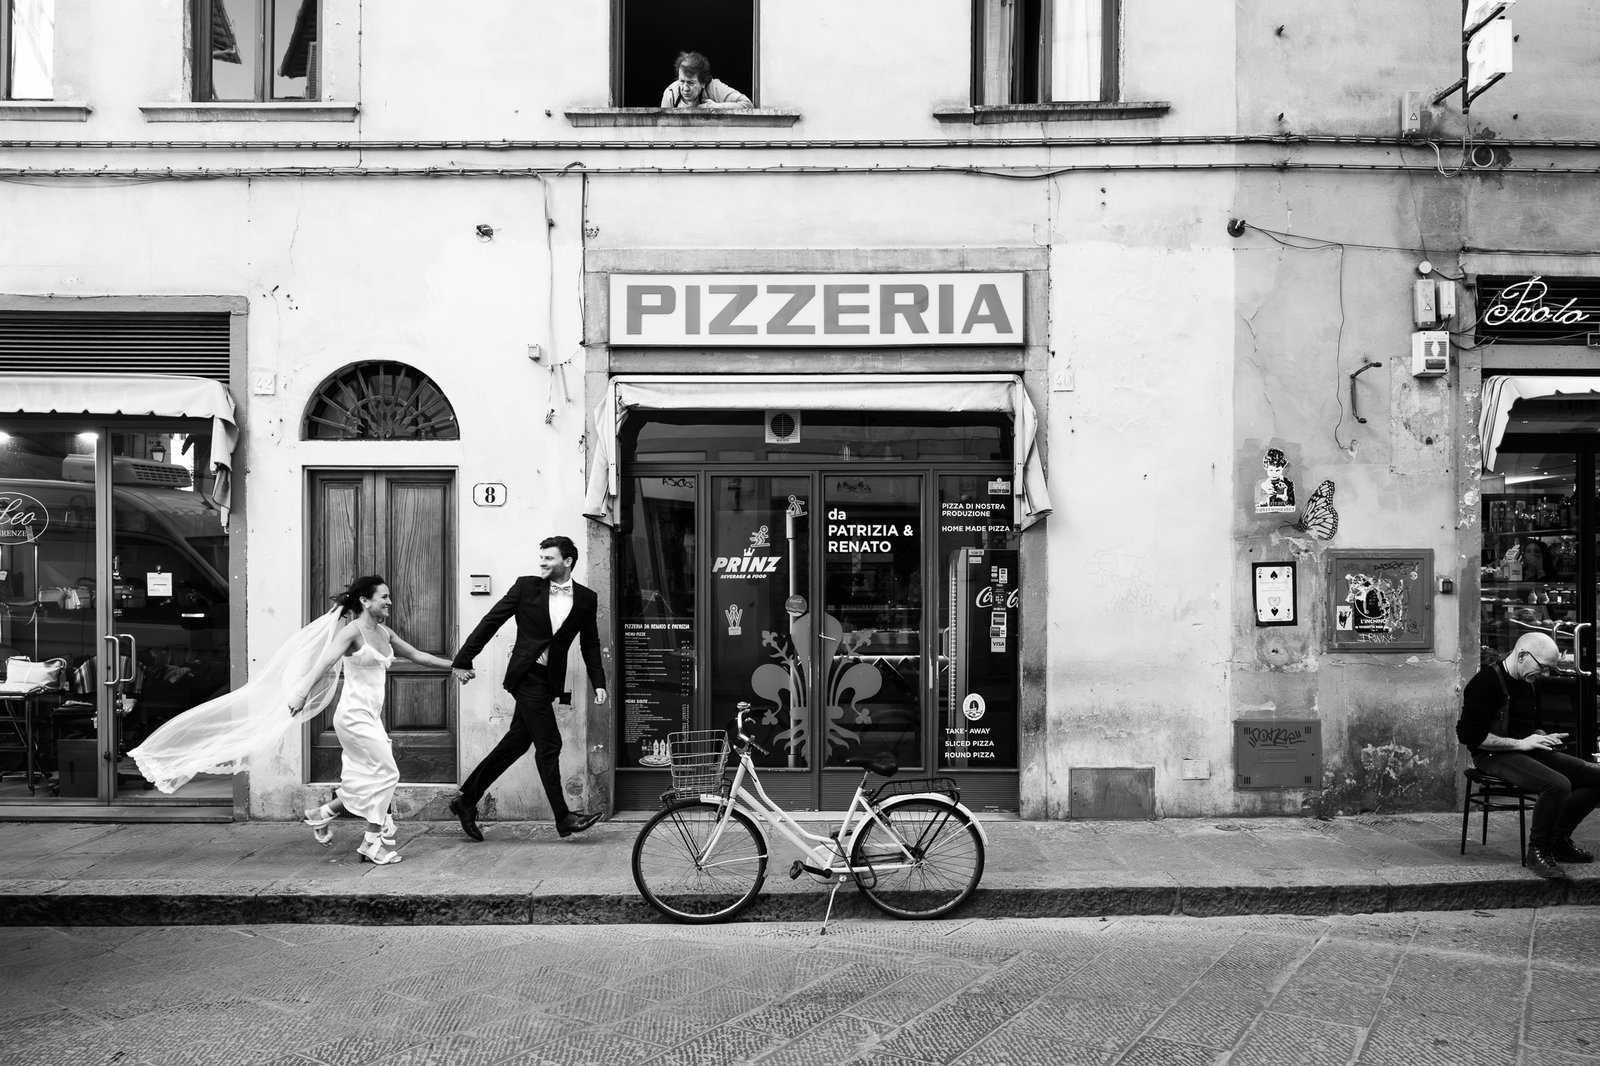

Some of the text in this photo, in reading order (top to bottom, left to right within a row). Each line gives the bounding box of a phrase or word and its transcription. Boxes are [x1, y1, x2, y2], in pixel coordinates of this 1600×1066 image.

[1484, 275, 1590, 325] Paolo
[626, 283, 1014, 335] PIZZERIA
[484, 486, 496, 504] 8
[828, 508, 847, 521] da
[828, 524, 914, 537] PATRIZIA &
[828, 540, 892, 554] RENATO
[712, 556, 782, 573] PRINZ
